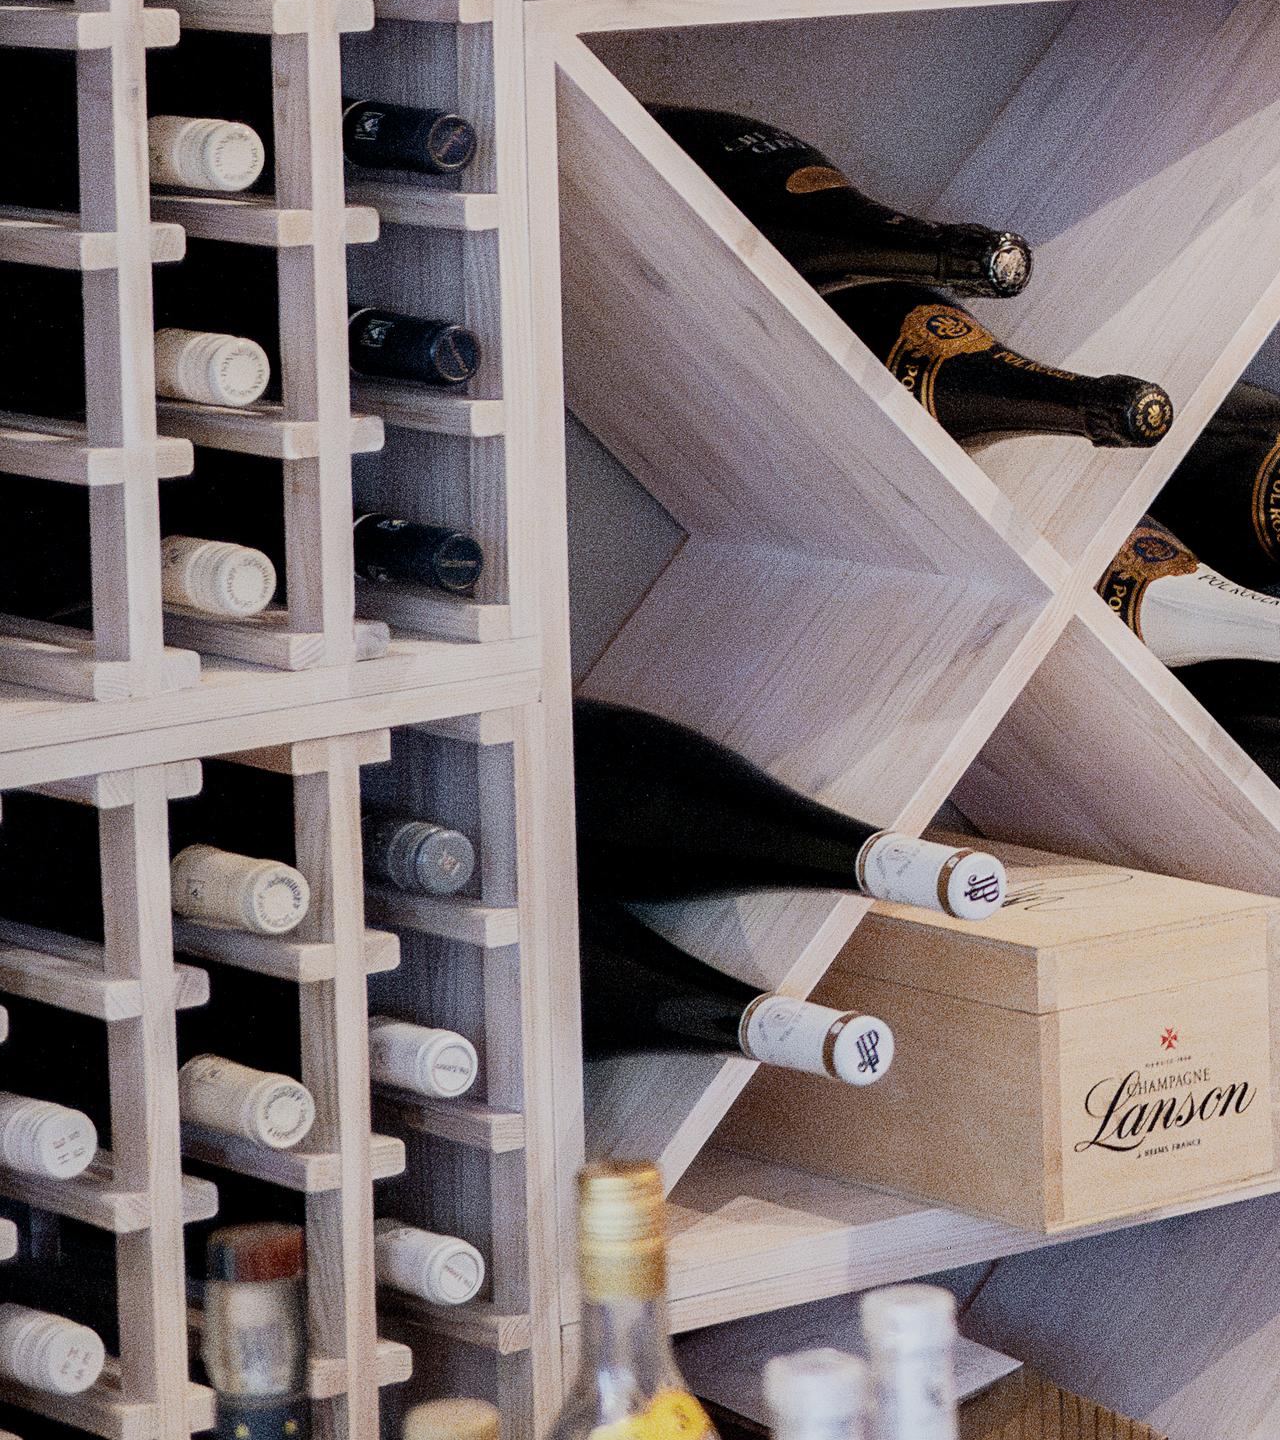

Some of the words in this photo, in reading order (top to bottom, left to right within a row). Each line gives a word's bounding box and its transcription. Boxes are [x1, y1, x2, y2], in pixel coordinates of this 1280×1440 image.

[1108, 583, 1127, 614] PO
[1126, 1067, 1212, 1097] CHAMPAGNE
[1073, 1069, 1259, 1153] Lanson
